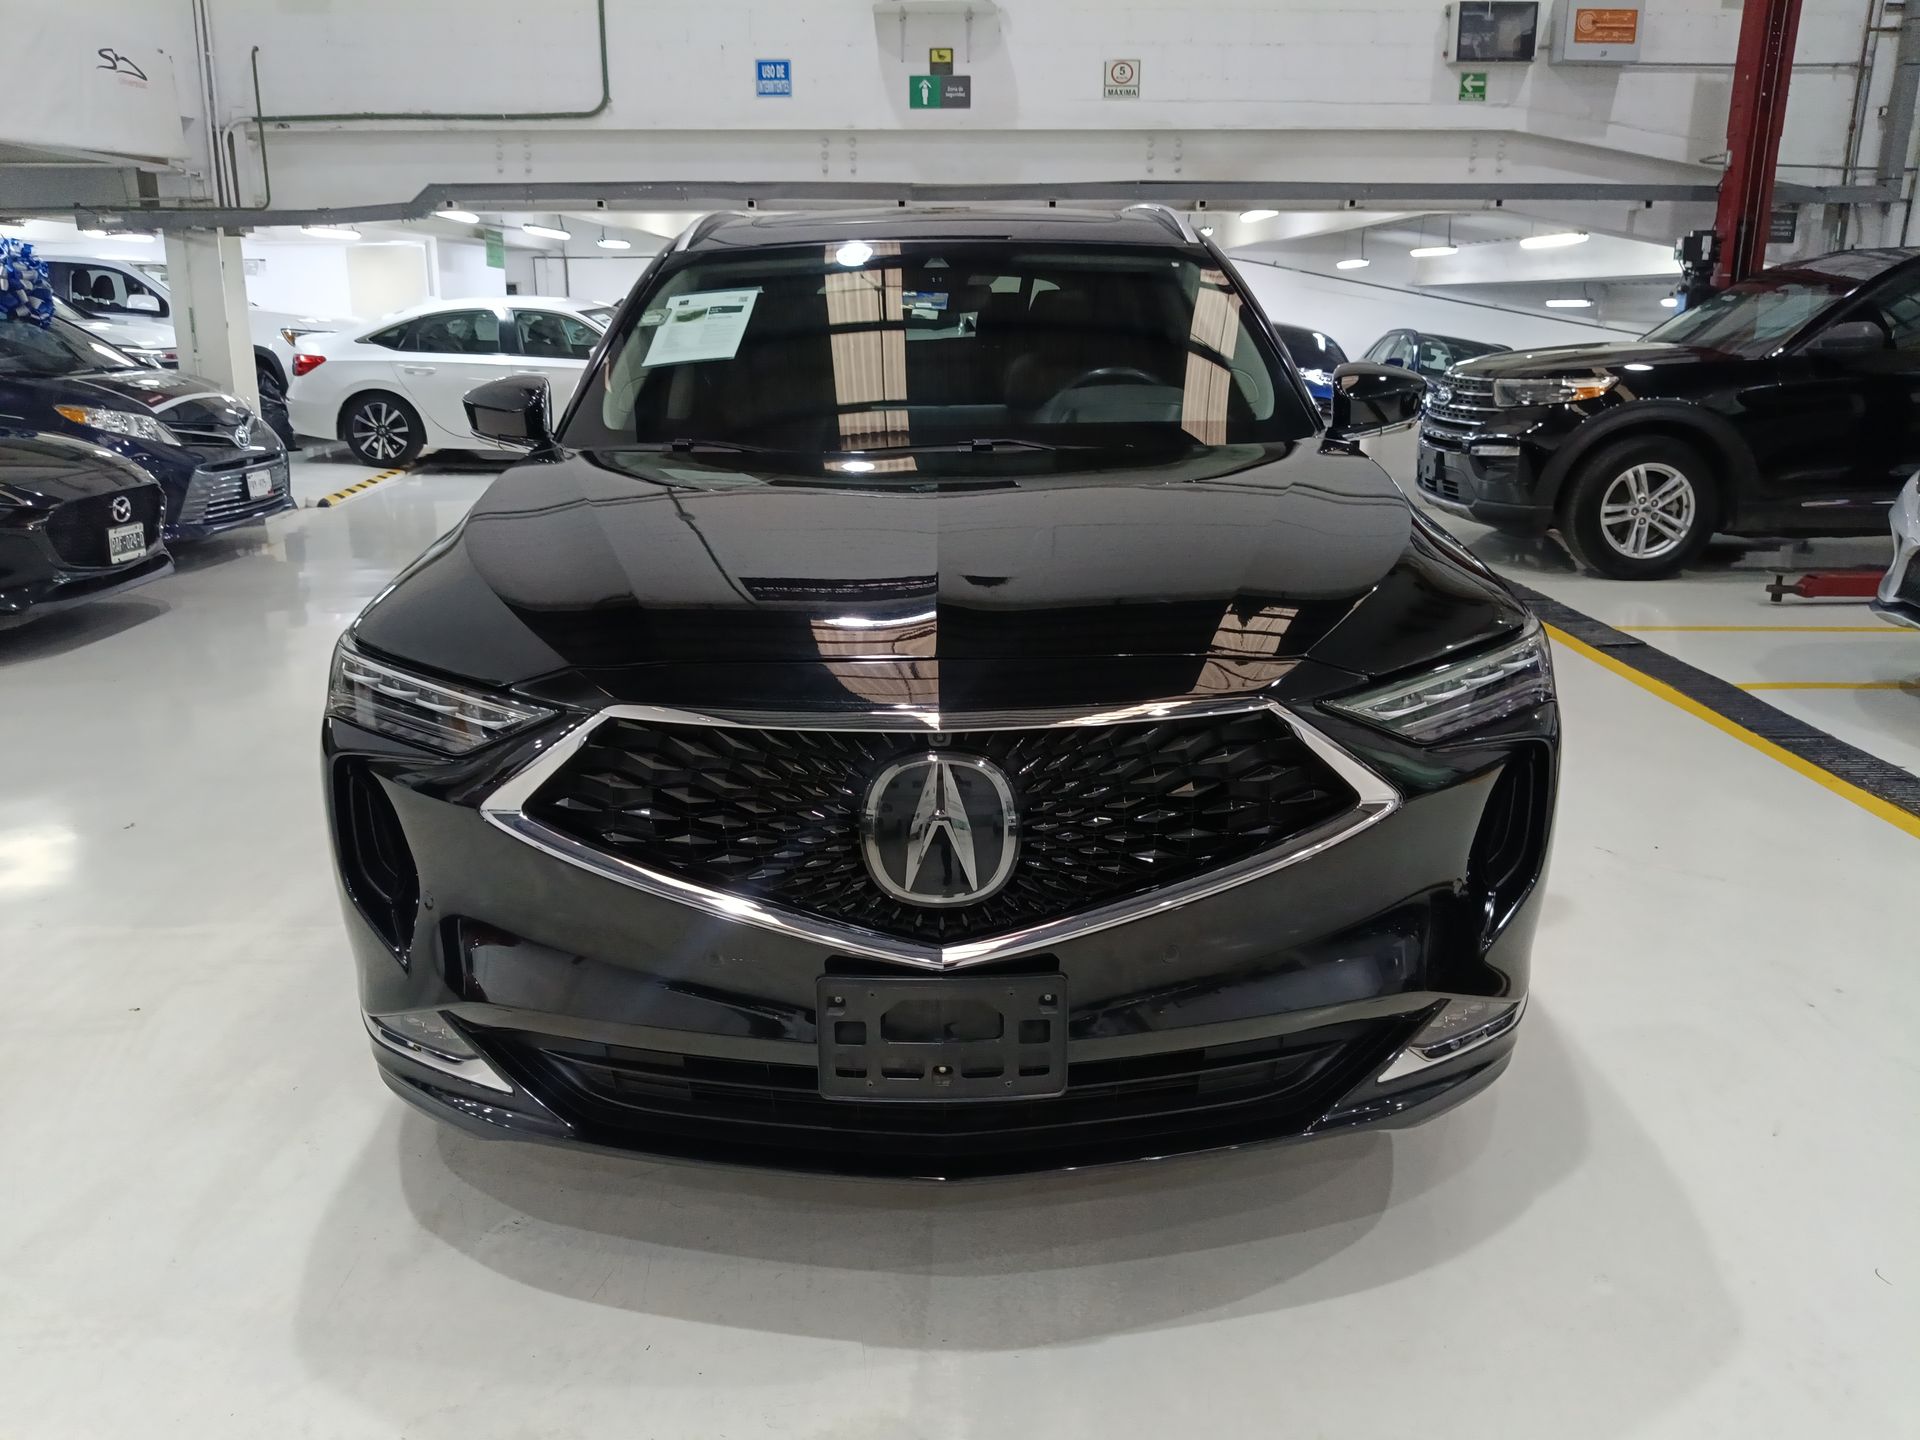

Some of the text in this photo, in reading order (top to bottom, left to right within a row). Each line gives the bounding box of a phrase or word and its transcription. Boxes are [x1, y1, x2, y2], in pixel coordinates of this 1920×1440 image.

[761, 64, 785, 78] USO DE
[1119, 66, 1126, 76] 5
